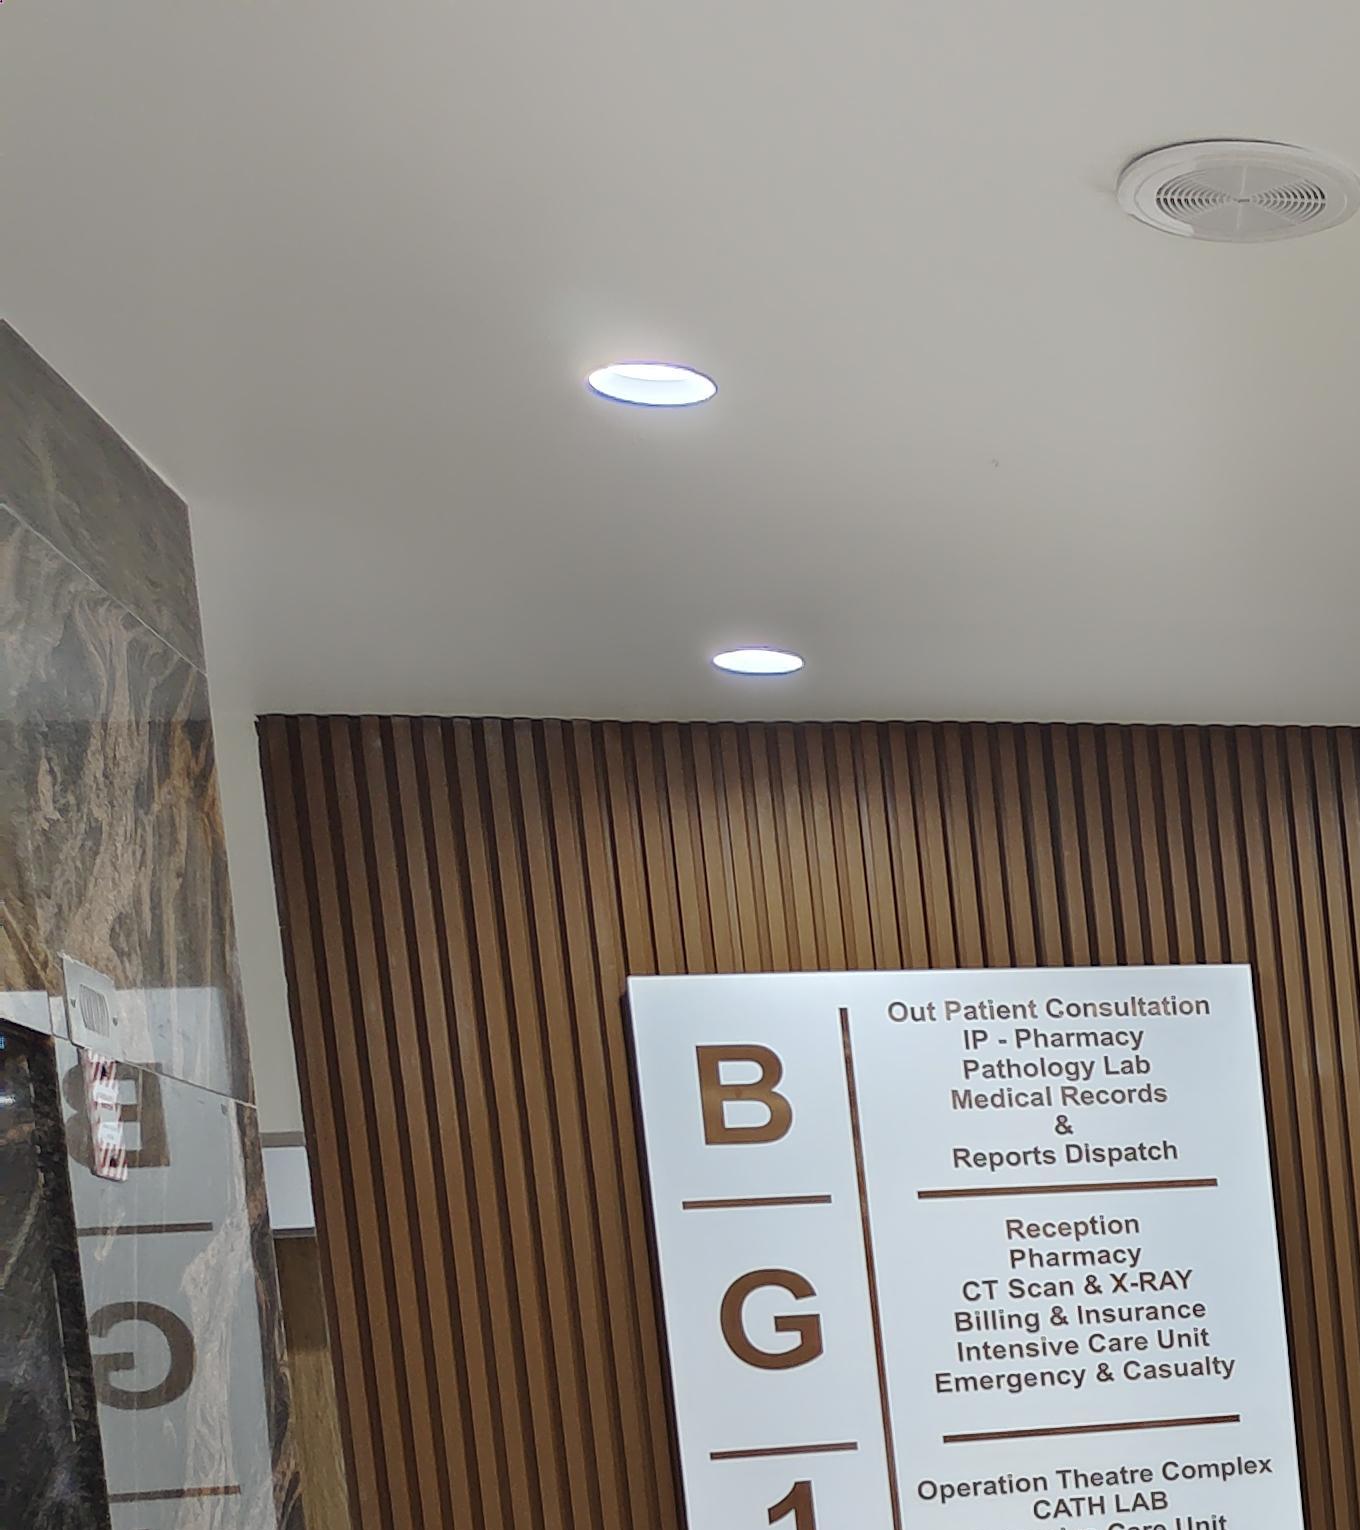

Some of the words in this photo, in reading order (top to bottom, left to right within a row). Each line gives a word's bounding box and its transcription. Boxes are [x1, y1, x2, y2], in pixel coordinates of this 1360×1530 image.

[888, 1002, 937, 1022] Out
[944, 999, 1038, 1021] Patient
[1046, 995, 1210, 1019] Consultation
[963, 1030, 988, 1050] IP
[1014, 1028, 1144, 1051] Pharmacy
[962, 1057, 1095, 1082] Pathology
[1103, 1054, 1150, 1075] Lab
[695, 1044, 793, 1146] B
[951, 1086, 1052, 1110] Medical
[1060, 1083, 1168, 1106] Records
[1054, 1114, 1074, 1136] &
[952, 1146, 1056, 1172] Reports
[1065, 1140, 1178, 1167] Dispatch
[1005, 1215, 1140, 1242] Reception
[1009, 1248, 1141, 1270] Pharmacy
[962, 1280, 999, 1302] CT
[1008, 1278, 1075, 1299] Scan
[1084, 1274, 1103, 1295] &
[1110, 1269, 1192, 1294] X-RAY
[720, 1268, 824, 1371] G
[954, 1309, 1040, 1334] Billing
[1050, 1305, 1069, 1327] &
[1077, 1303, 1206, 1325] Insurance
[957, 1336, 1079, 1363] Intensive
[1088, 1333, 1149, 1354] Care
[1157, 1327, 1210, 1350] Unit
[935, 1368, 1086, 1394] Emergency
[1096, 1362, 1115, 1383] &
[1123, 1356, 1236, 1381] Casualty
[917, 1474, 1048, 1502] Operation
[1055, 1466, 1153, 1490] Theatre
[1162, 1456, 1272, 1482] Complex
[1033, 1495, 1106, 1520] CATH
[1114, 1491, 1168, 1513] LAB
